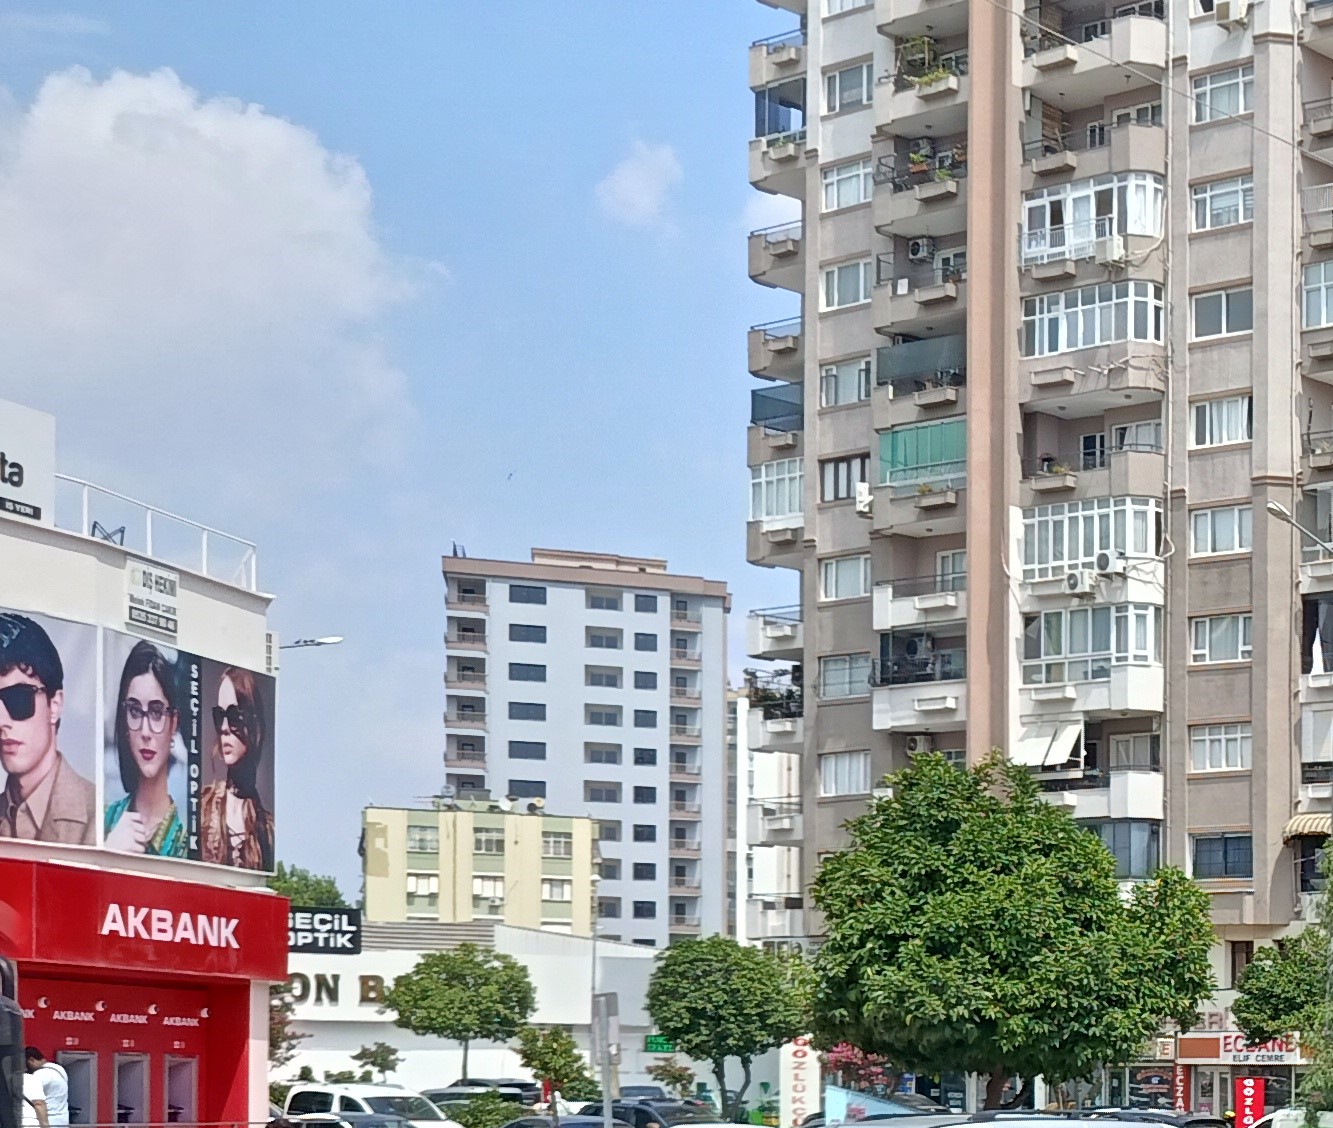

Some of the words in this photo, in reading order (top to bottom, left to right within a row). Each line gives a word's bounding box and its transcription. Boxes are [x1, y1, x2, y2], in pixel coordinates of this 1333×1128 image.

[189, 763, 199, 850] OPTİK
[101, 903, 240, 949] AKBANK
[53, 1010, 95, 1022] AKBANK
[109, 1013, 149, 1025] AKBANK
[162, 1016, 200, 1027] AKBANK
